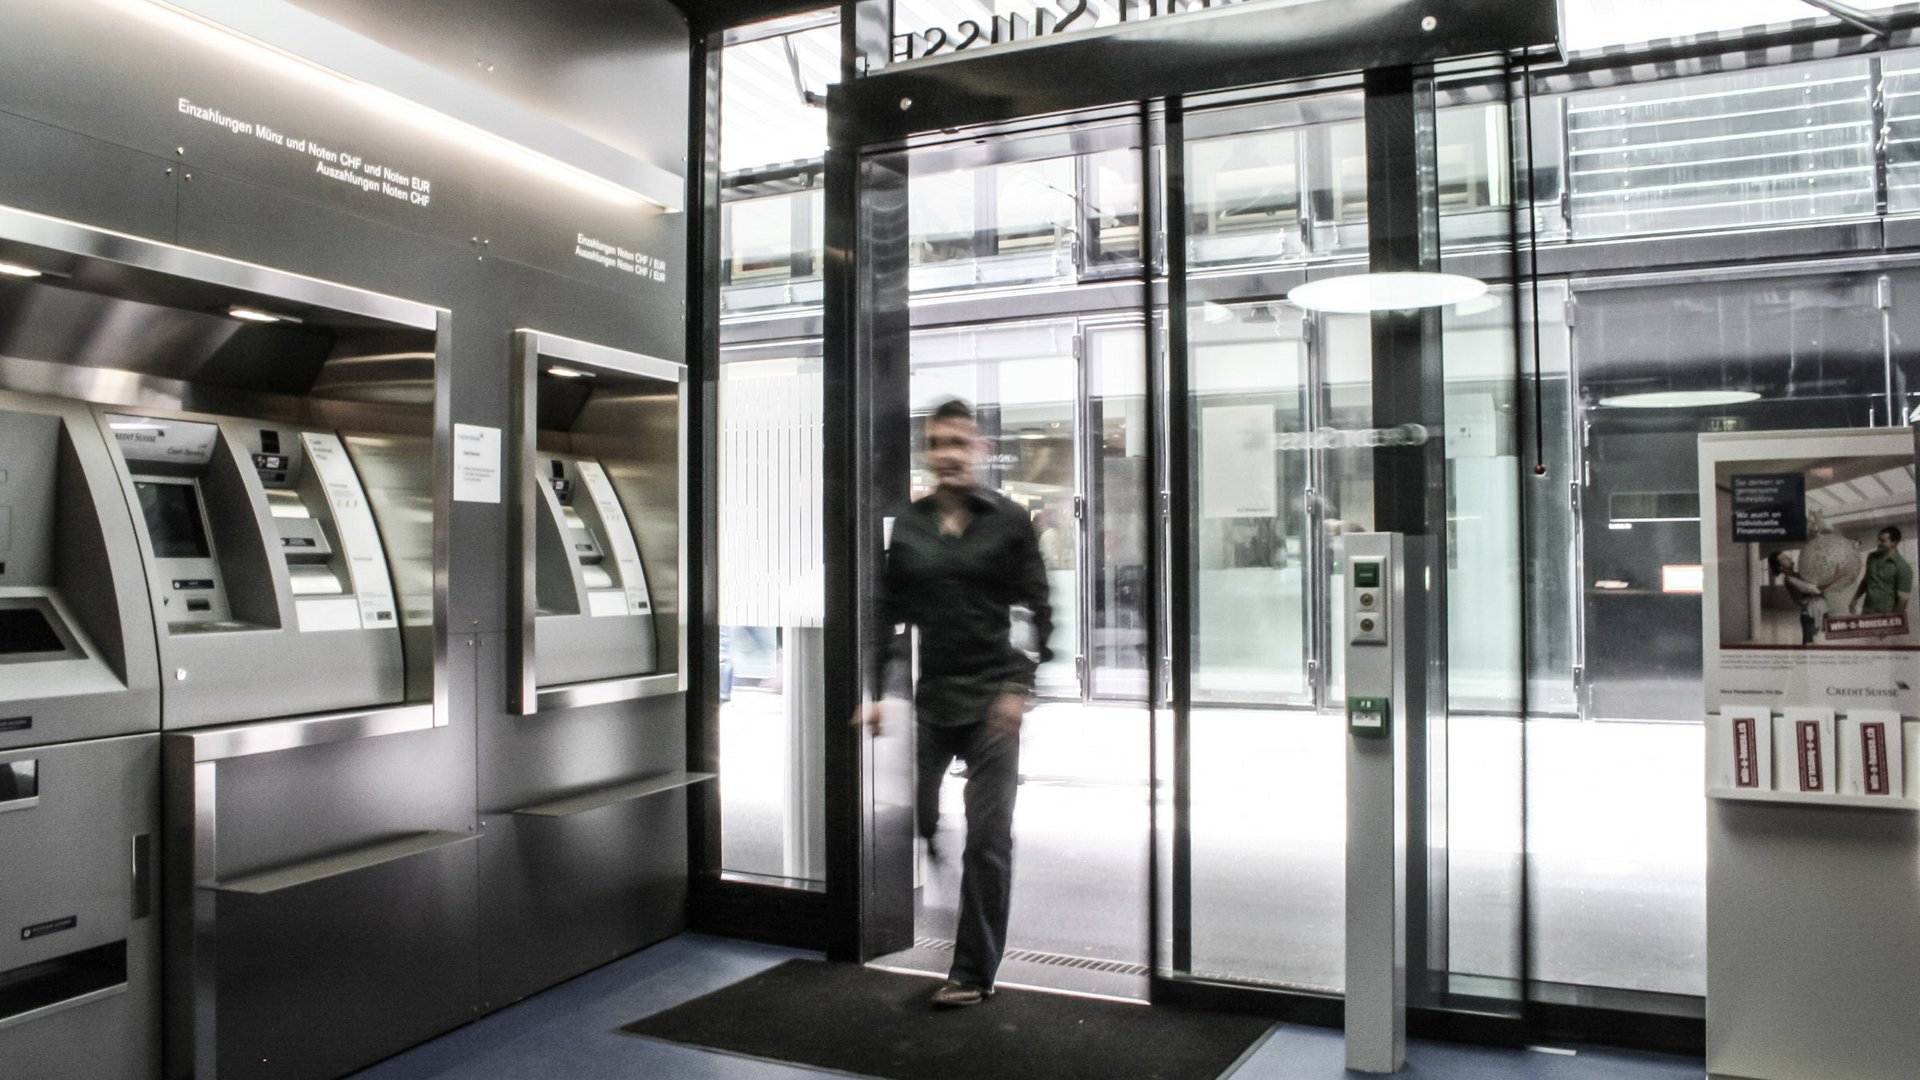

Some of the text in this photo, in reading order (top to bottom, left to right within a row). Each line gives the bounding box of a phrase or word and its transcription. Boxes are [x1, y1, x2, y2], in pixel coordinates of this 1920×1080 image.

[178, 98, 431, 194] Einzahlungen Münz und Noten CHF und Noten EUR
[316, 161, 430, 208] Auszahlungen Noten CHF
[617, 246, 635, 261] Noten
[635, 252, 649, 265] CHF
[653, 258, 666, 271] EUR
[617, 258, 635, 273] Noten
[1826, 686, 1898, 698] CREDIT SUISSE
